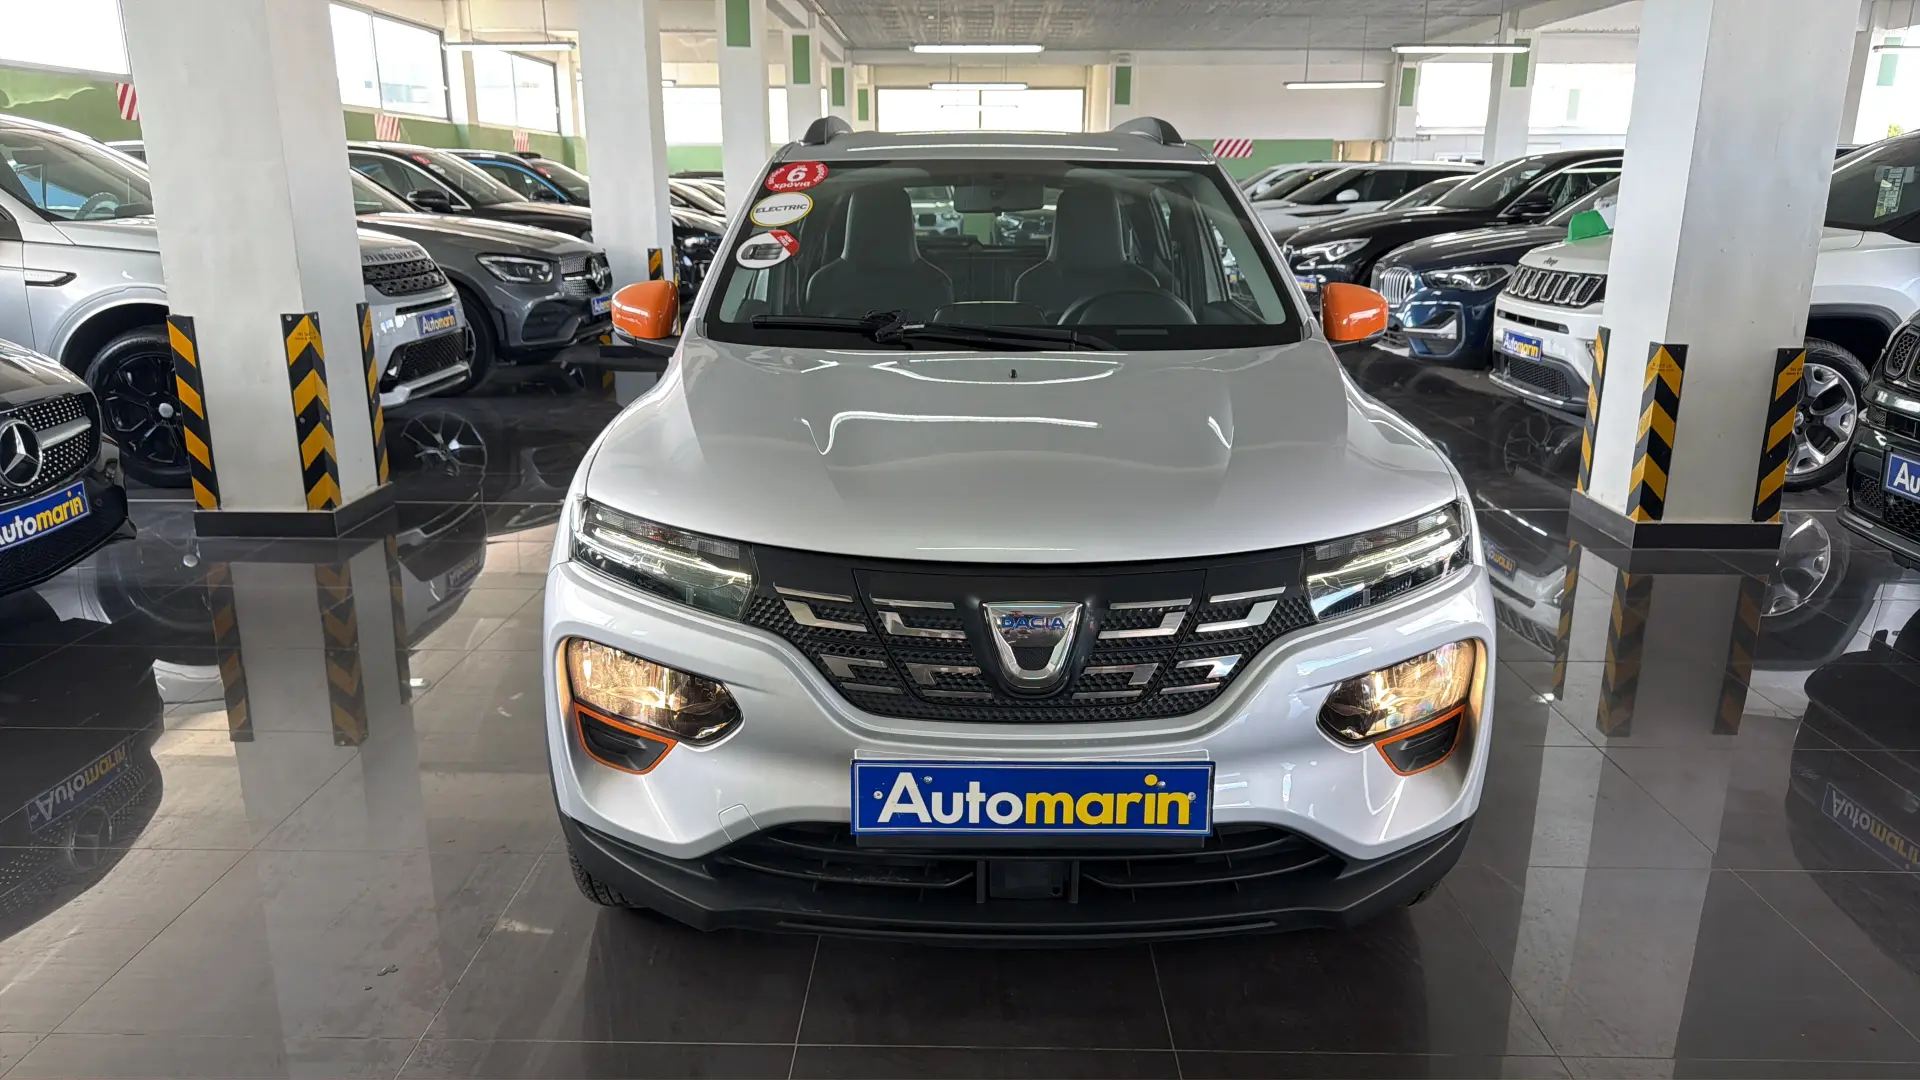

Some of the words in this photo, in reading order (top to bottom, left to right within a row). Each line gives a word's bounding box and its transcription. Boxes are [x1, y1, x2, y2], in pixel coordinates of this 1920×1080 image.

[787, 167, 808, 182] 6
[773, 181, 811, 190] χρόνια
[755, 203, 808, 213] ELECTRIC
[422, 311, 456, 334] Automarin
[1001, 616, 1066, 630] DACIA
[877, 771, 1190, 826] Automarin
